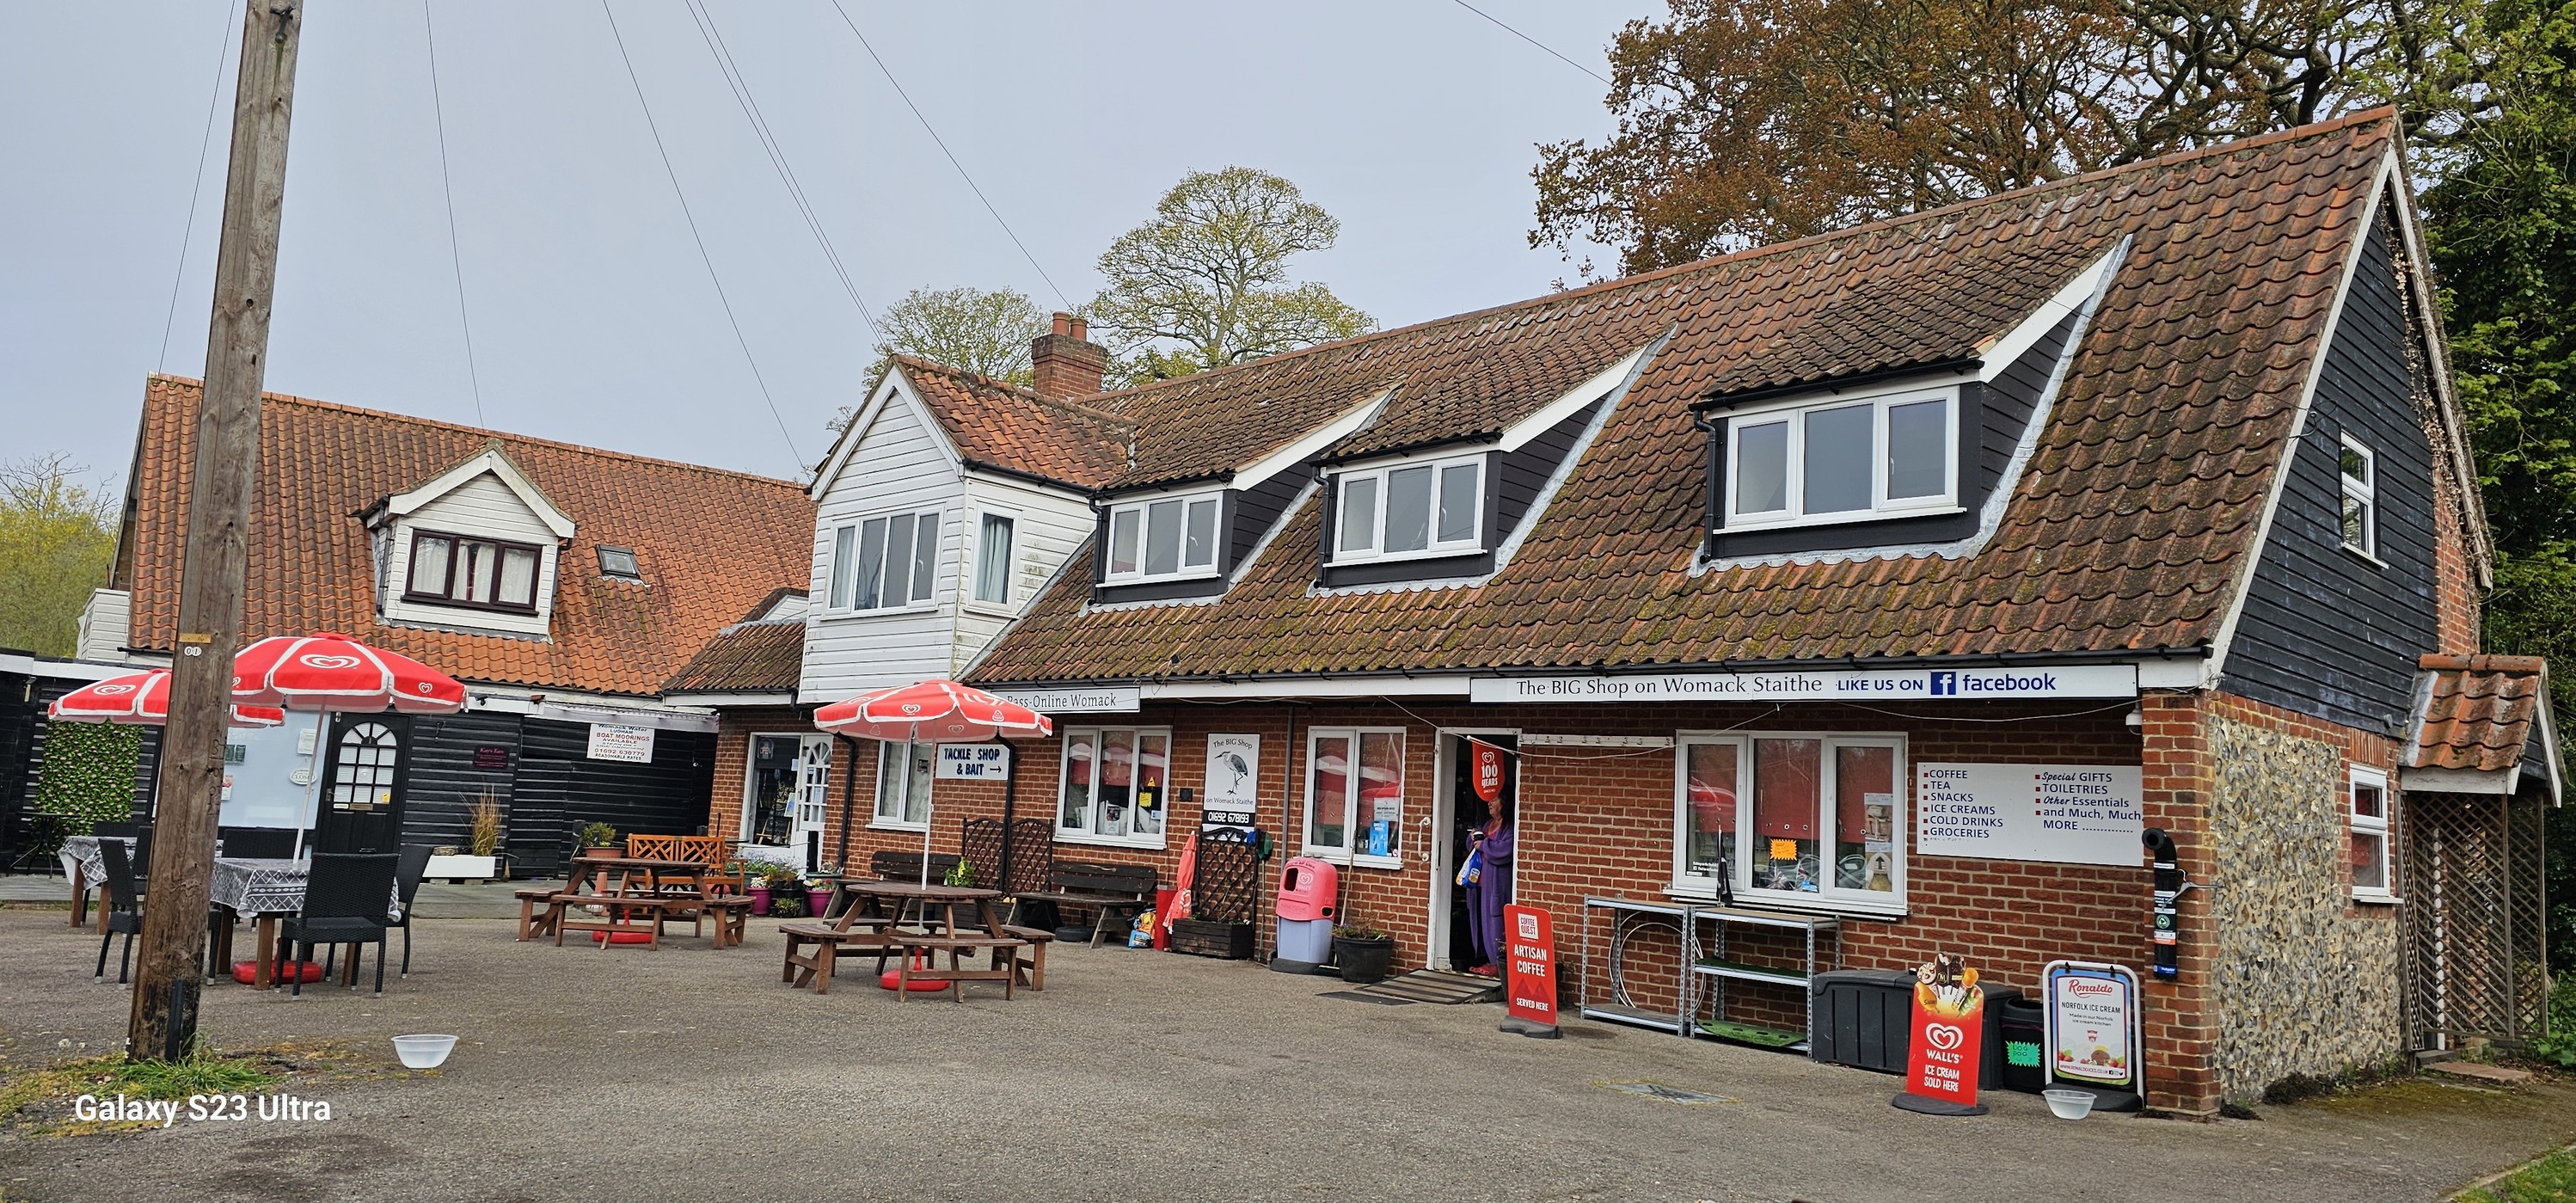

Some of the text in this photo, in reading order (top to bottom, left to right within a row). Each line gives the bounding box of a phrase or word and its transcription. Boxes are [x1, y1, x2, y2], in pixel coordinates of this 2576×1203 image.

[1517, 674, 1822, 698] The BIG Shop on Womack Staithe
[1837, 679, 1869, 690] LIKE
[1874, 679, 1894, 690] US
[1899, 679, 1923, 690] ON
[1962, 672, 2057, 691] facebook
[1070, 692, 1117, 707] Womack
[1238, 739, 1253, 750] Shop
[944, 748, 1000, 761] TACKLE SHOP
[956, 764, 984, 776] & BAIT
[1481, 762, 1499, 779] 100
[1929, 769, 1968, 779] COFFEE
[1481, 777, 1499, 789] YEARS
[2041, 772, 2113, 783] Special GIFTS
[1930, 781, 1951, 789] TEA
[2043, 783, 2108, 795] TOILETRIES
[1930, 793, 1974, 802] SNACKS
[2043, 795, 2130, 808] Other Essentials
[1930, 804, 1996, 815] ICE CREAMS
[2043, 807, 2064, 817] and
[2069, 808, 2104, 820] Much,
[1207, 812, 1226, 822] 01692
[1929, 815, 2003, 827] COLD DRINKS
[2043, 820, 2078, 831] MORE
[1929, 827, 1990, 838] GROCERIES
[1520, 917, 1536, 927] COFFEE
[1521, 925, 1536, 936] QUEST
[1514, 944, 1547, 961] ARTISAN
[1517, 960, 1546, 977] COFFEE
[2069, 979, 2113, 995] Ronaldo
[1516, 997, 1549, 1012] SERVED HERE
[2062, 1001, 2121, 1014] NORFOLK ICE CREAM
[1926, 1049, 1960, 1065] WALL'S
[1924, 1065, 1960, 1080] ICE CREAM
[1924, 1076, 1959, 1092] SOLD HERE
